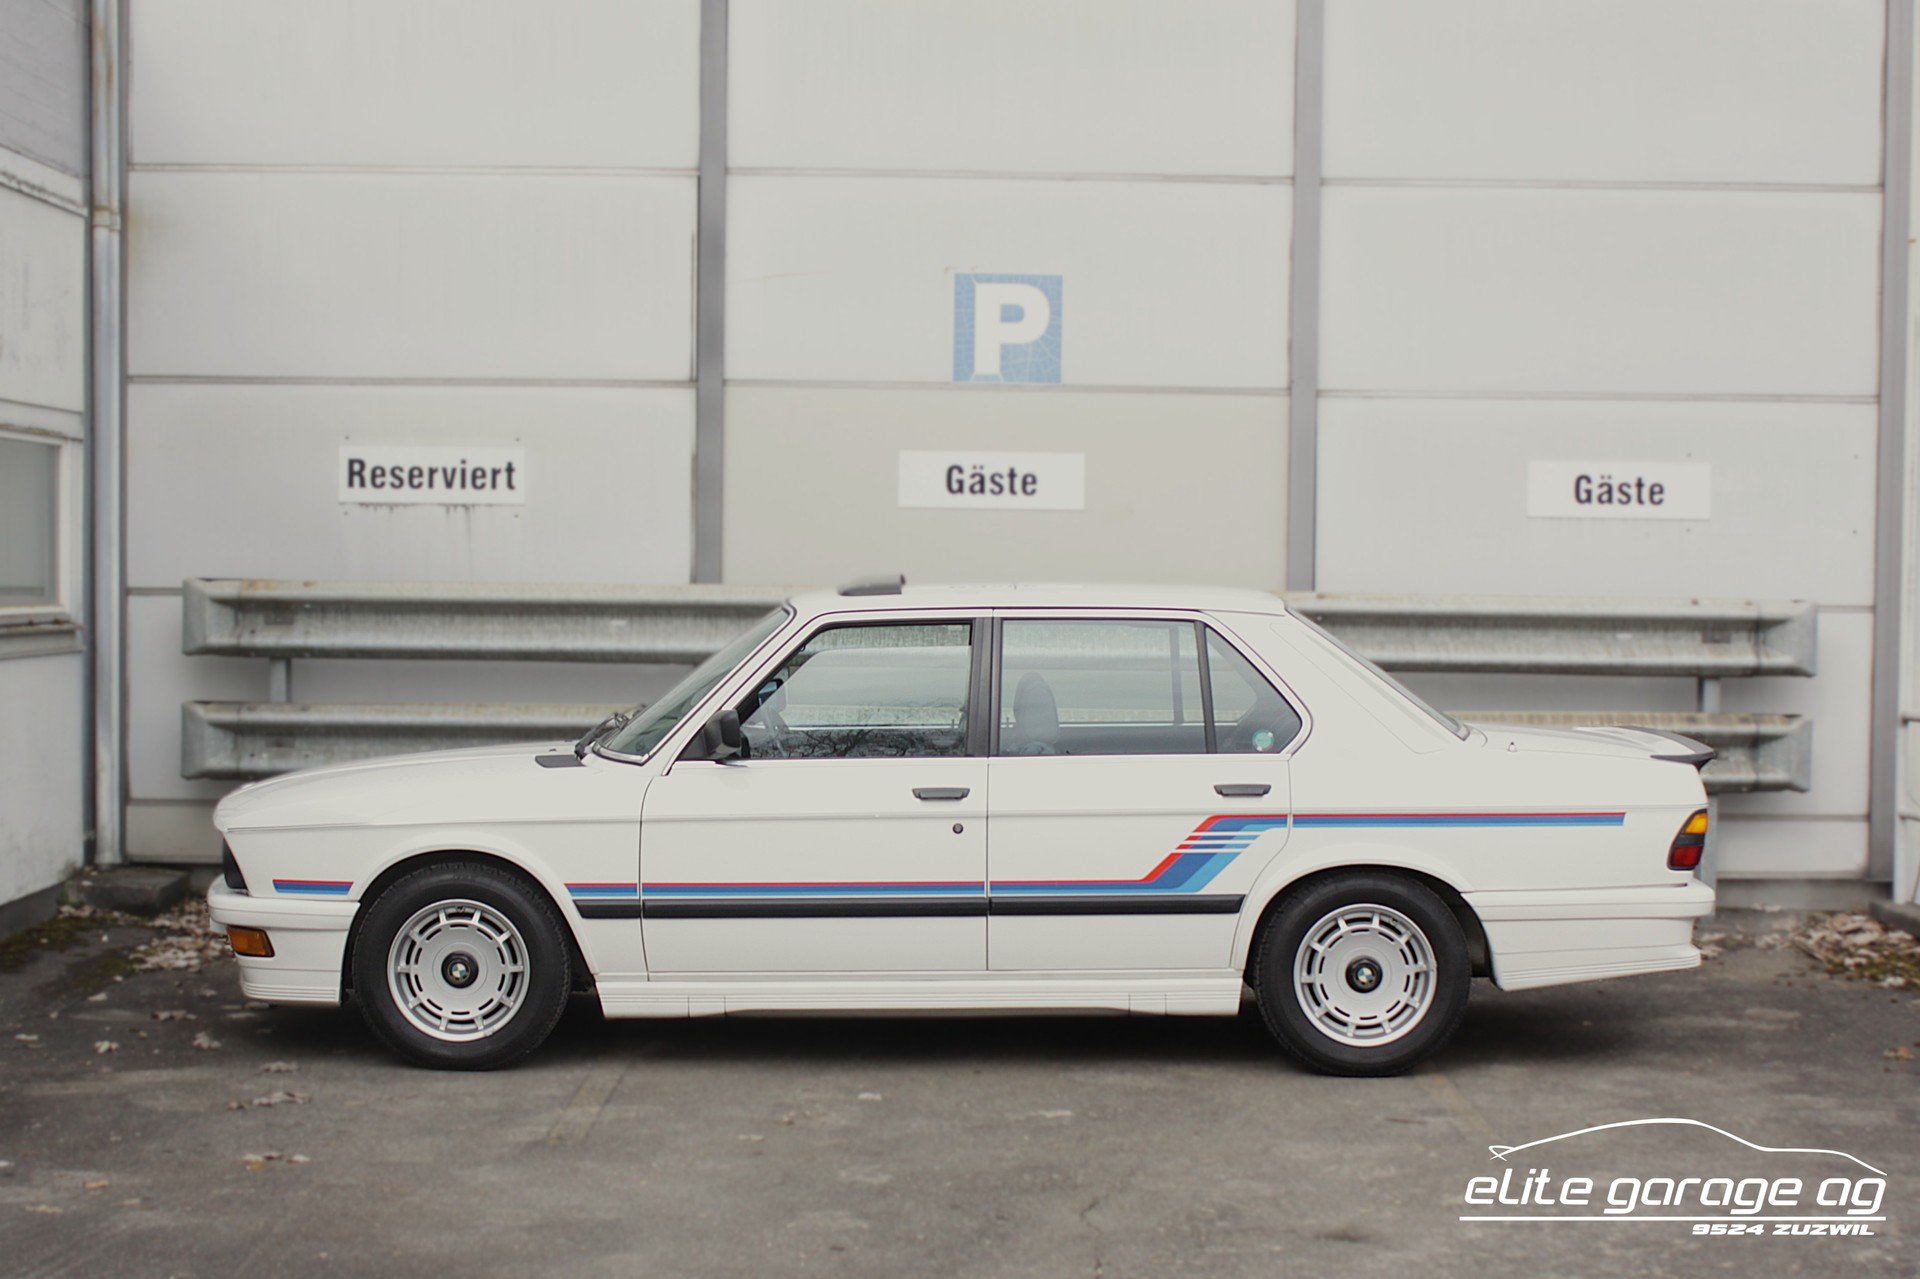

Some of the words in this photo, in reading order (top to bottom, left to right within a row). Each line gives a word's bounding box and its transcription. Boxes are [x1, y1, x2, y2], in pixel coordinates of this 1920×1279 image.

[974, 283, 1050, 374] P
[347, 458, 515, 490] Reserviert
[945, 465, 1038, 496] Gäste
[1574, 474, 1664, 505] Gäste
